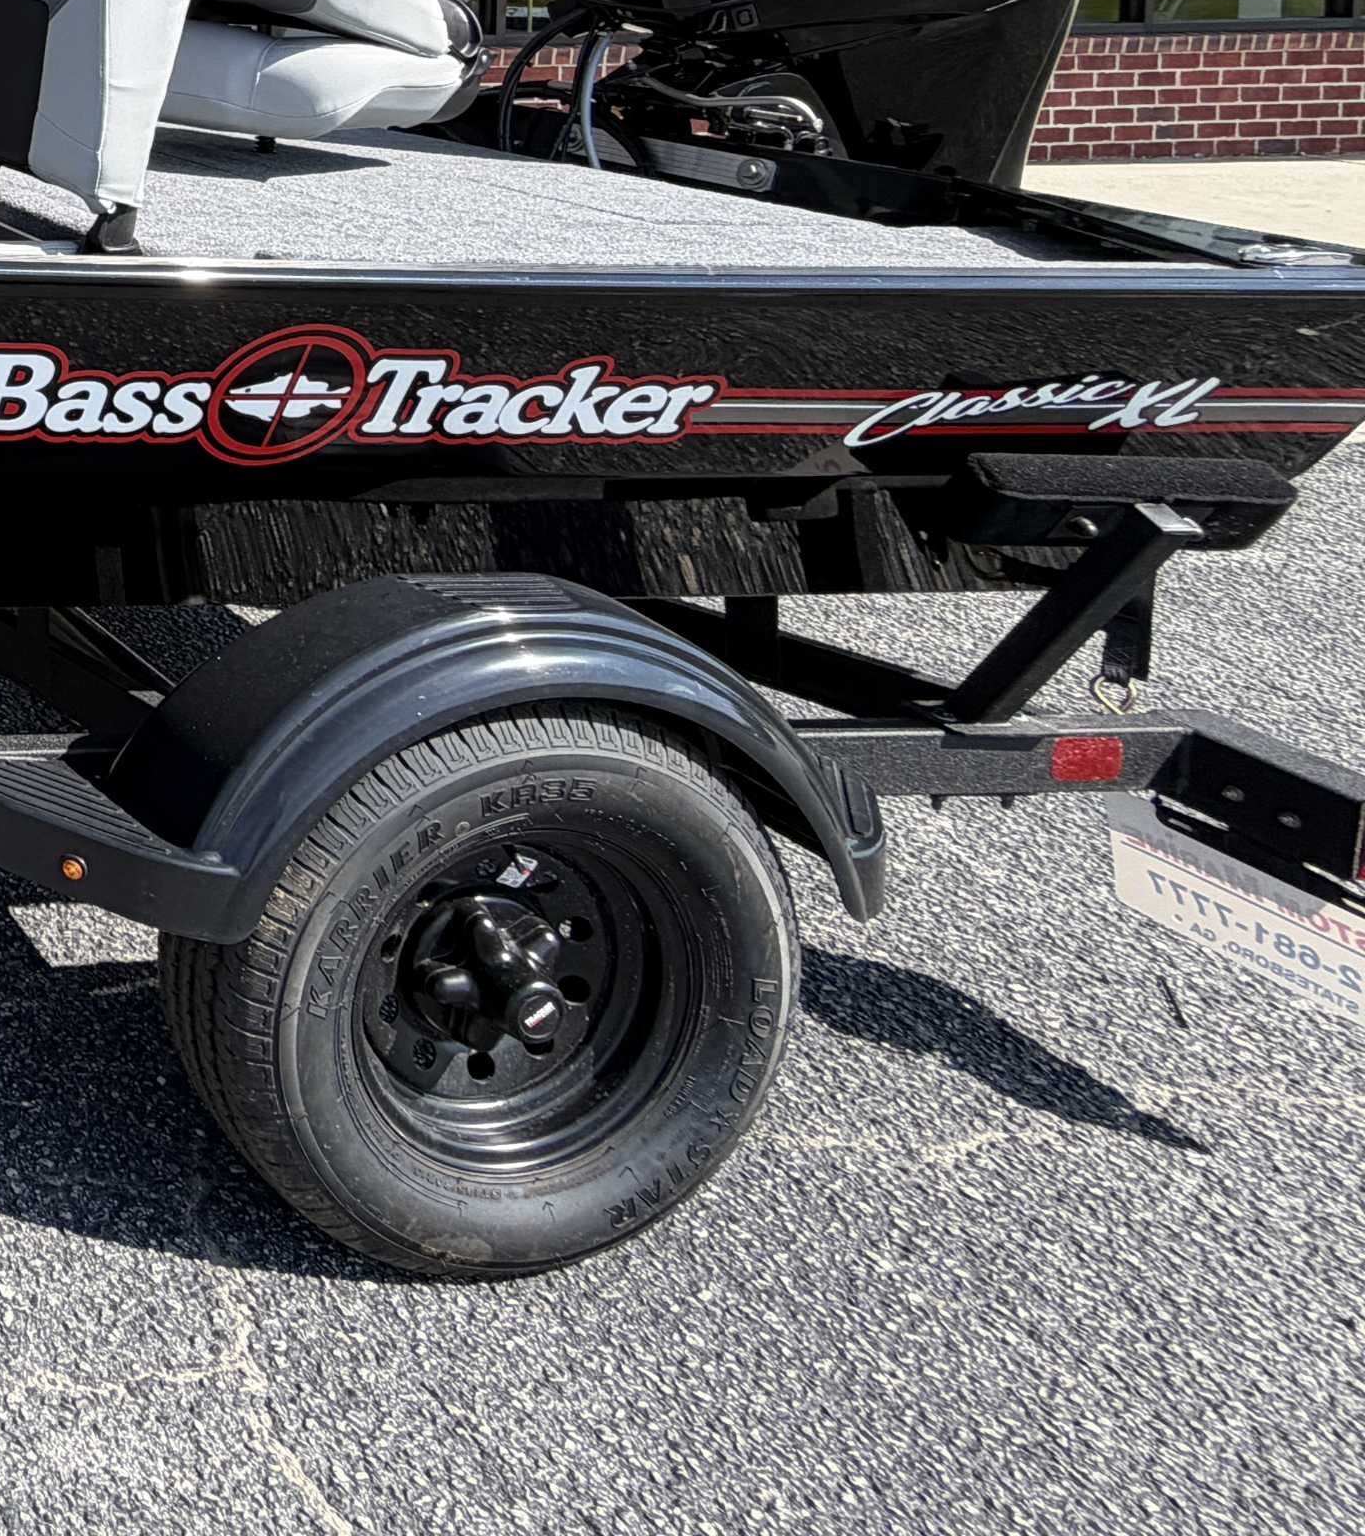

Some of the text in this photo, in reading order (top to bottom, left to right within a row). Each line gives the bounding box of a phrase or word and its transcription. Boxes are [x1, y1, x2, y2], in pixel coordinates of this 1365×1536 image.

[356, 358, 714, 437] Tracker
[843, 374, 1221, 448] Classic XL
